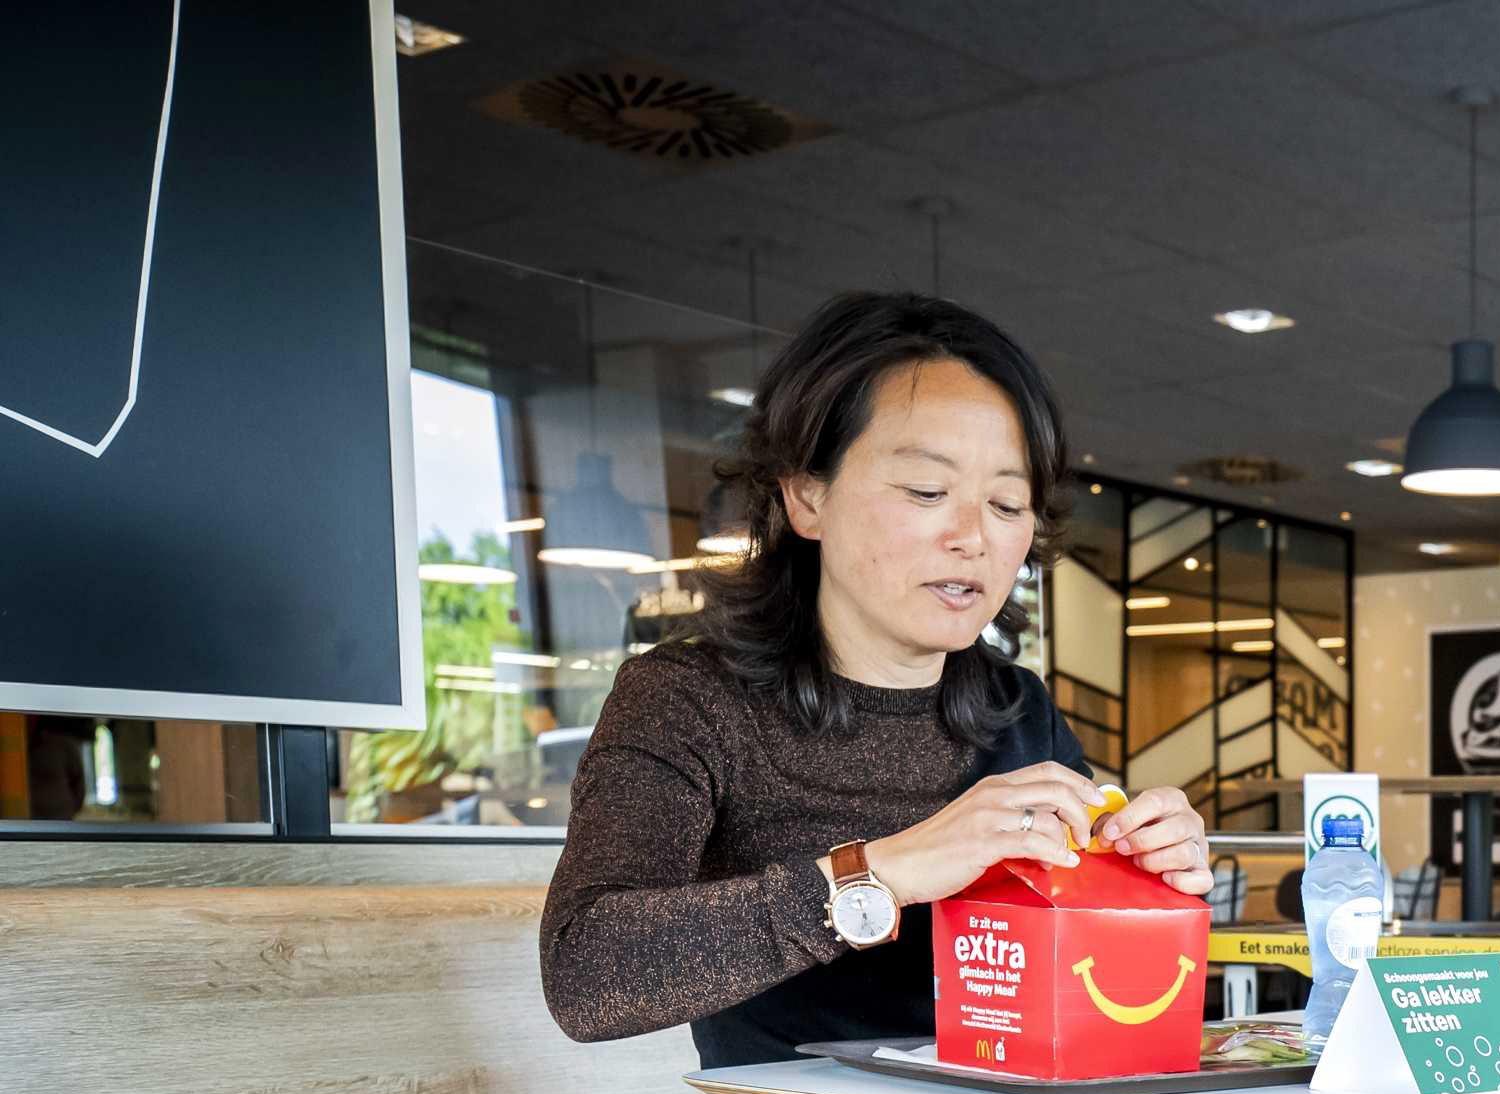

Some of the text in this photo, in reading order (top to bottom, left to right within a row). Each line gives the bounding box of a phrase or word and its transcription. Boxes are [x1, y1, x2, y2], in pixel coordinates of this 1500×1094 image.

[969, 916, 1009, 931] Er zit een
[954, 931, 1026, 969] extra
[1239, 941, 1260, 955] Eet
[1265, 942, 1310, 956] smake
[1376, 944, 1420, 957] ctloze
[959, 965, 1021, 983] glimlach in het
[966, 980, 993, 997] Happy
[1391, 984, 1482, 1009] Ga lekker
[1401, 1010, 1462, 1034] zitten
